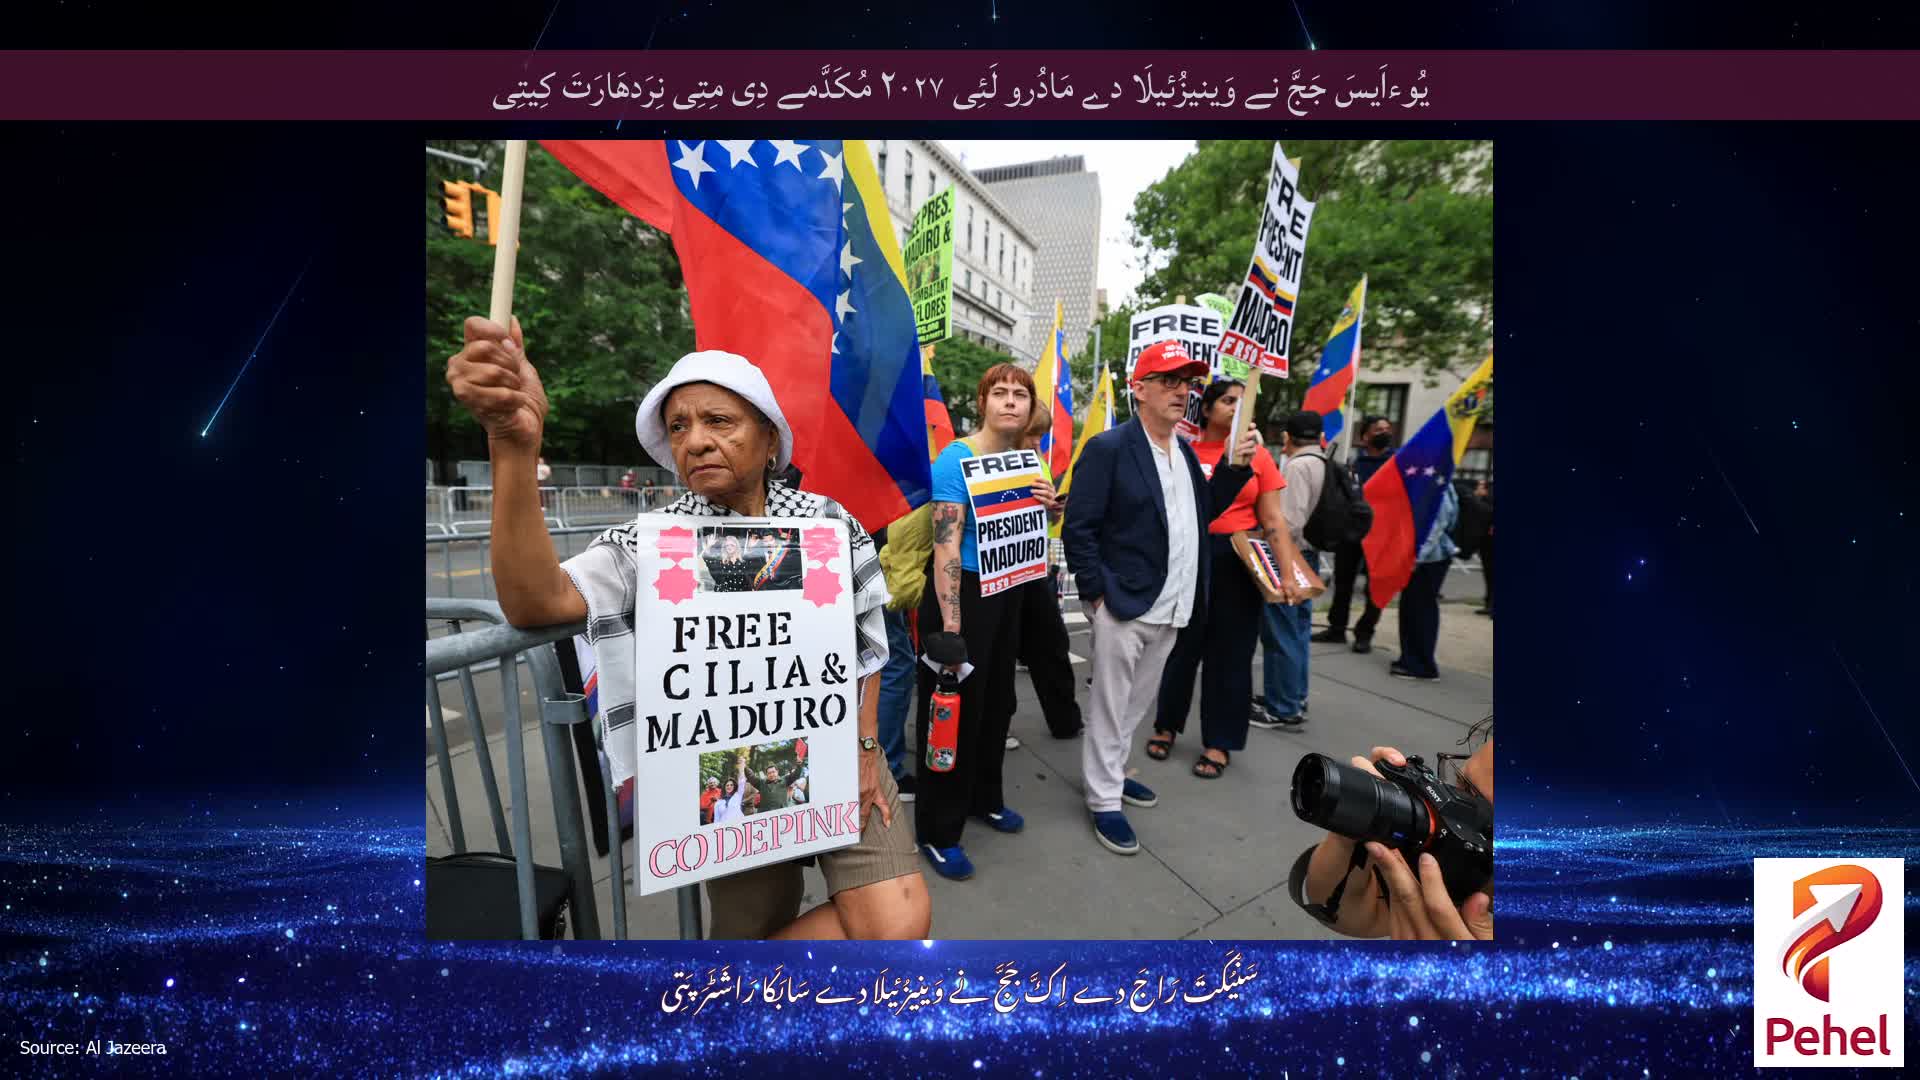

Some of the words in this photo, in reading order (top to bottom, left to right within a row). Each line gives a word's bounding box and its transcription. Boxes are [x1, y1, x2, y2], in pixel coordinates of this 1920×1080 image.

[921, 191, 951, 229] PRES.
[904, 225, 940, 268] MADURO
[943, 220, 951, 244] &
[916, 296, 946, 324] FLORES
[1132, 314, 1220, 340] FREE
[962, 452, 1039, 478] FREE
[978, 510, 1045, 543] PRESIDENT
[980, 536, 1045, 575] MADURO
[672, 611, 793, 653] FREE
[663, 654, 810, 700] CILIA
[820, 652, 848, 685] &
[645, 693, 848, 753] MADURO
[1425, 785, 1442, 803] SONY
